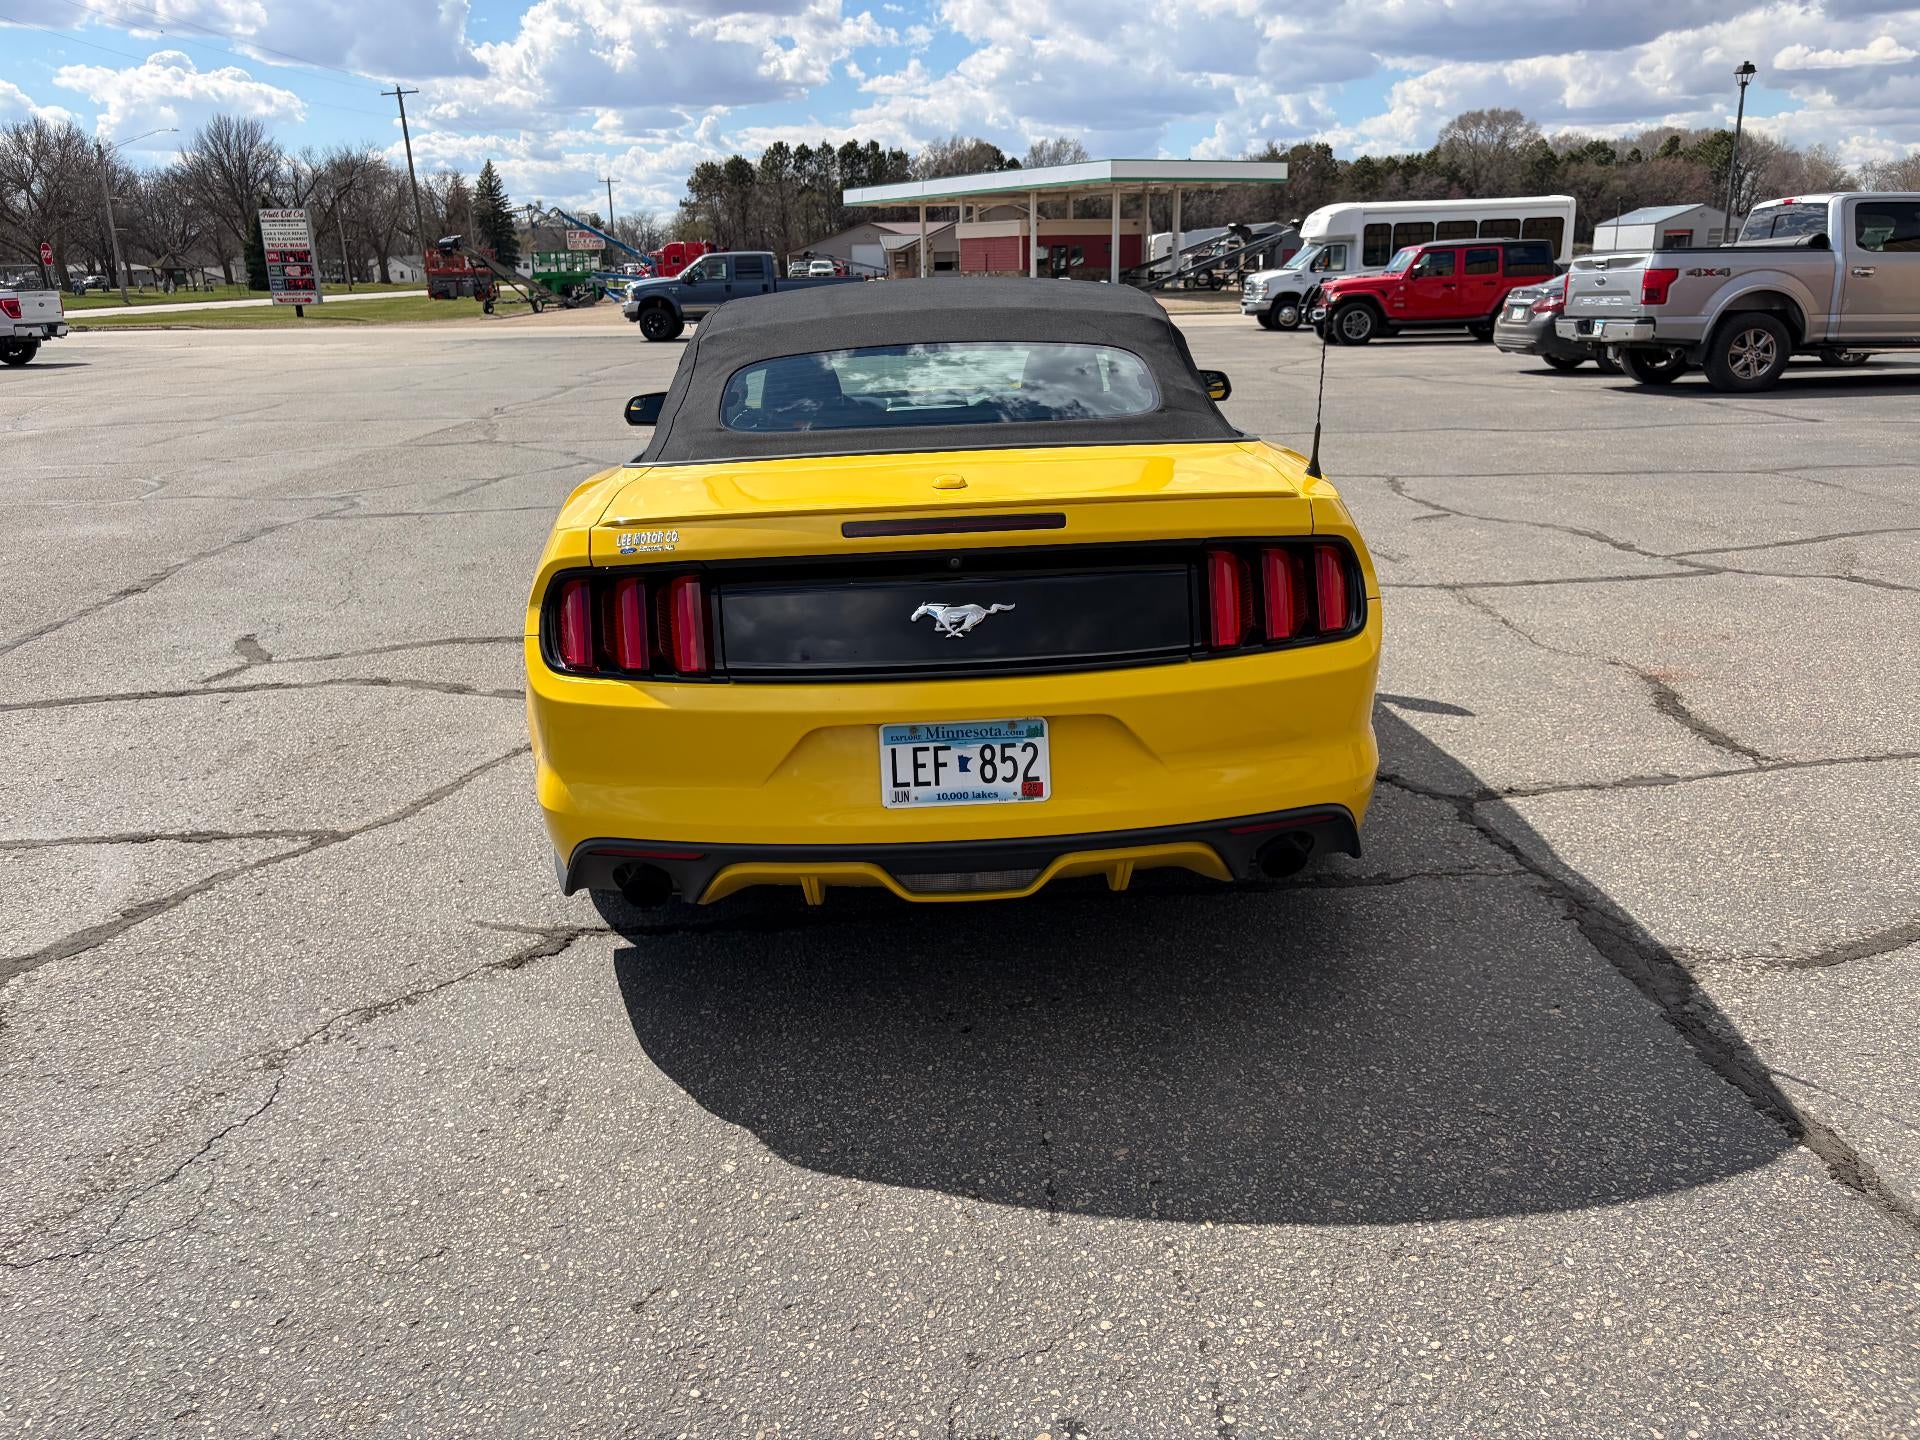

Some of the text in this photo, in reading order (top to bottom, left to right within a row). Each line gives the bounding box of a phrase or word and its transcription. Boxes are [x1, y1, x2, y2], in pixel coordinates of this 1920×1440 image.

[616, 534, 632, 546] LEE
[633, 532, 664, 545] MOTOR
[890, 722, 1025, 743] EXPLORE Minnesota.com
[890, 741, 1041, 788] LEF 852
[892, 790, 999, 803] JUN 10,000 lakes
